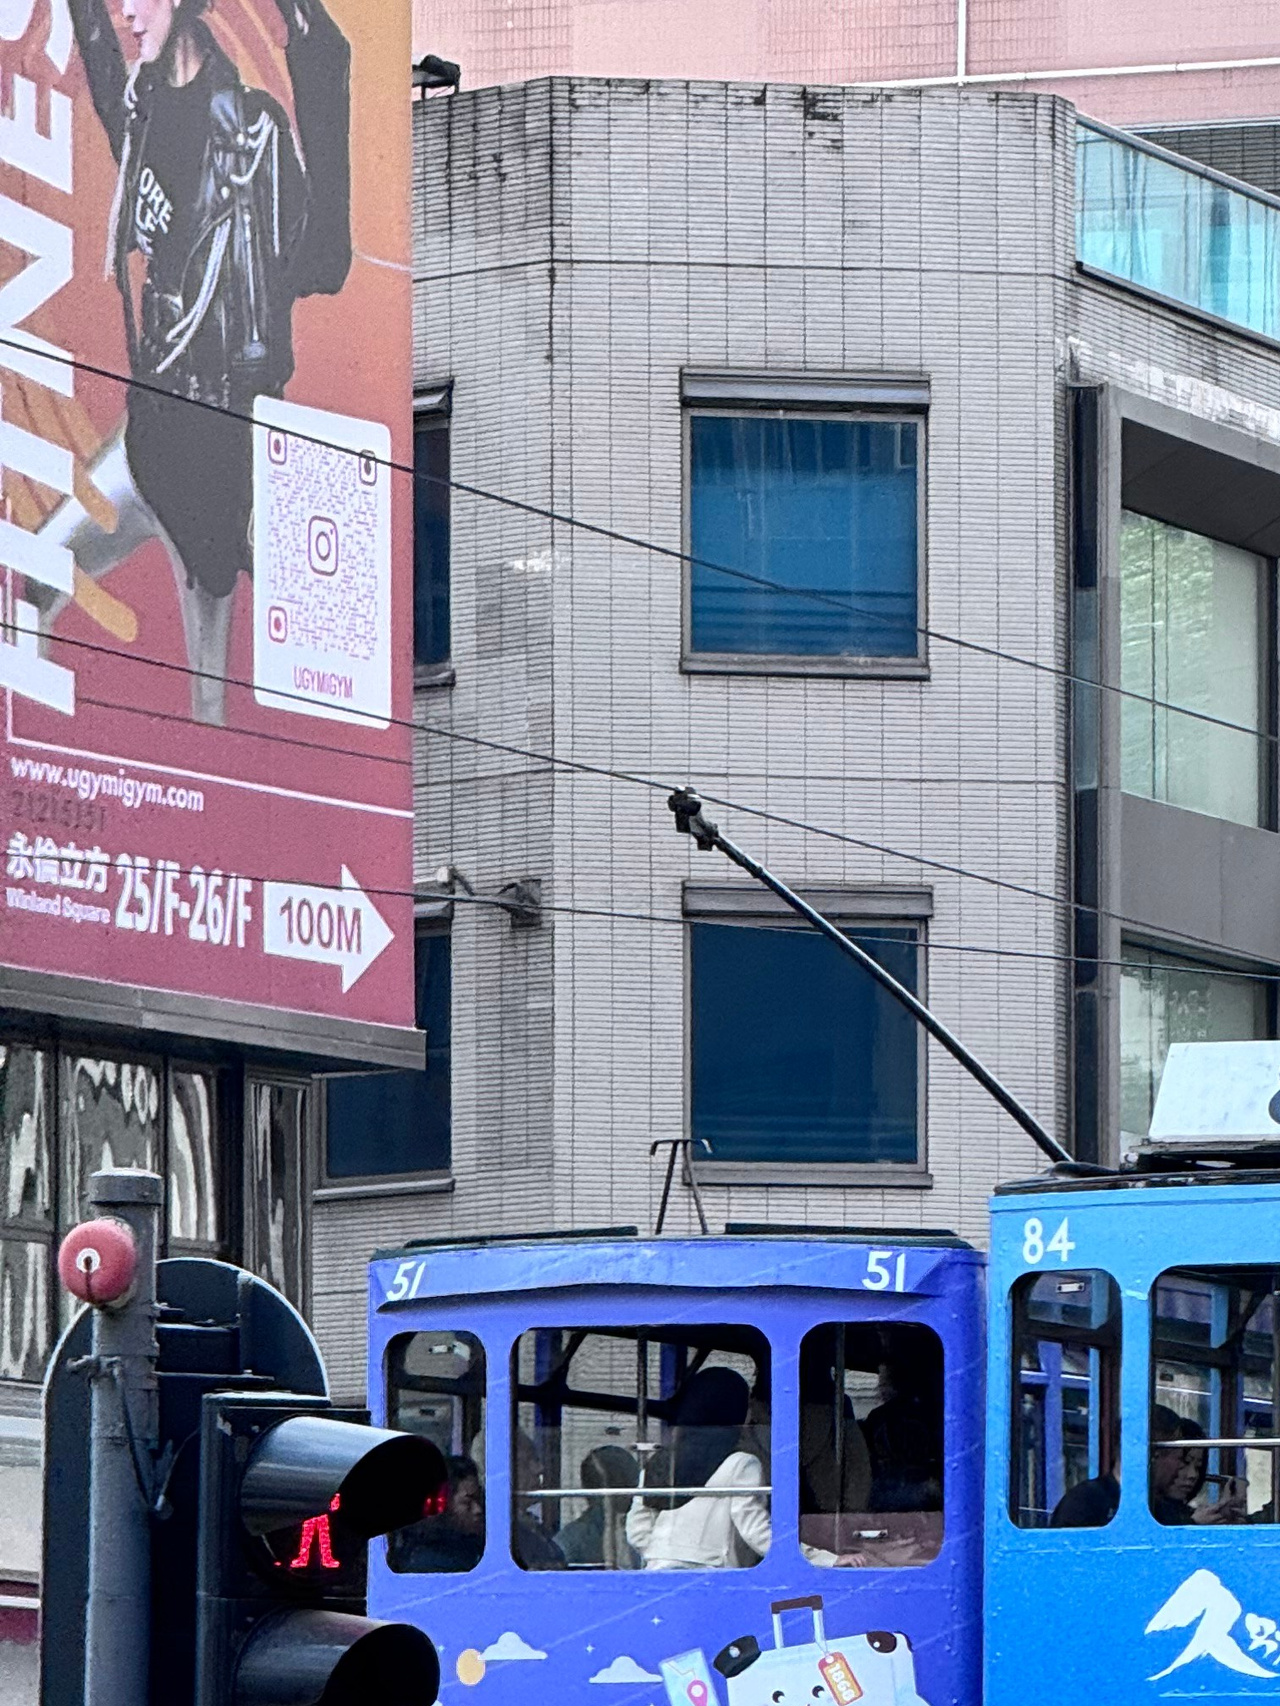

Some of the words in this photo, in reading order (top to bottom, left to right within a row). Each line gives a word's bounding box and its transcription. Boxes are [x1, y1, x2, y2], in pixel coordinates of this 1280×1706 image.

[10, 756, 205, 812] www.ugymigym.com
[62, 895, 111, 924] Square
[115, 852, 253, 949] 25/F-26/F
[279, 895, 362, 955] 100M
[1022, 1216, 1076, 1265] 84
[386, 1261, 427, 1301] 51
[861, 1250, 905, 1293] 51
